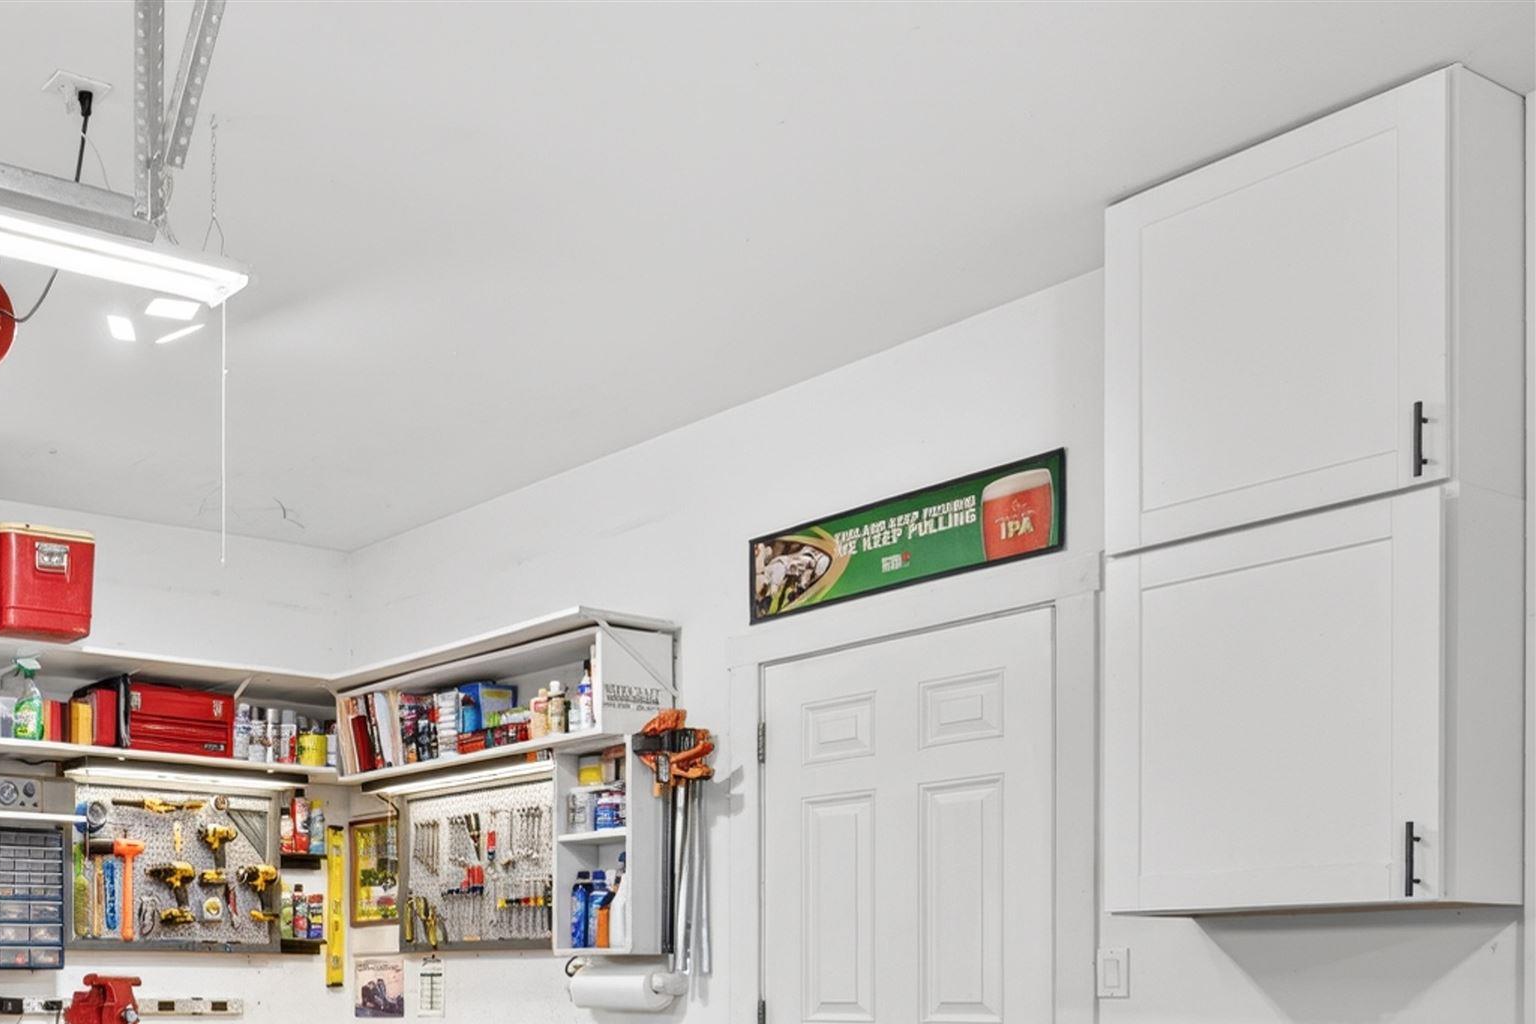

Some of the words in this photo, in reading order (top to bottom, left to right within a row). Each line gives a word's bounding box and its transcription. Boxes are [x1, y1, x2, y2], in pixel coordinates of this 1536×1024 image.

[862, 528, 902, 552] KEEP
[907, 508, 977, 540] PULLING
[999, 516, 1035, 540] IPA
